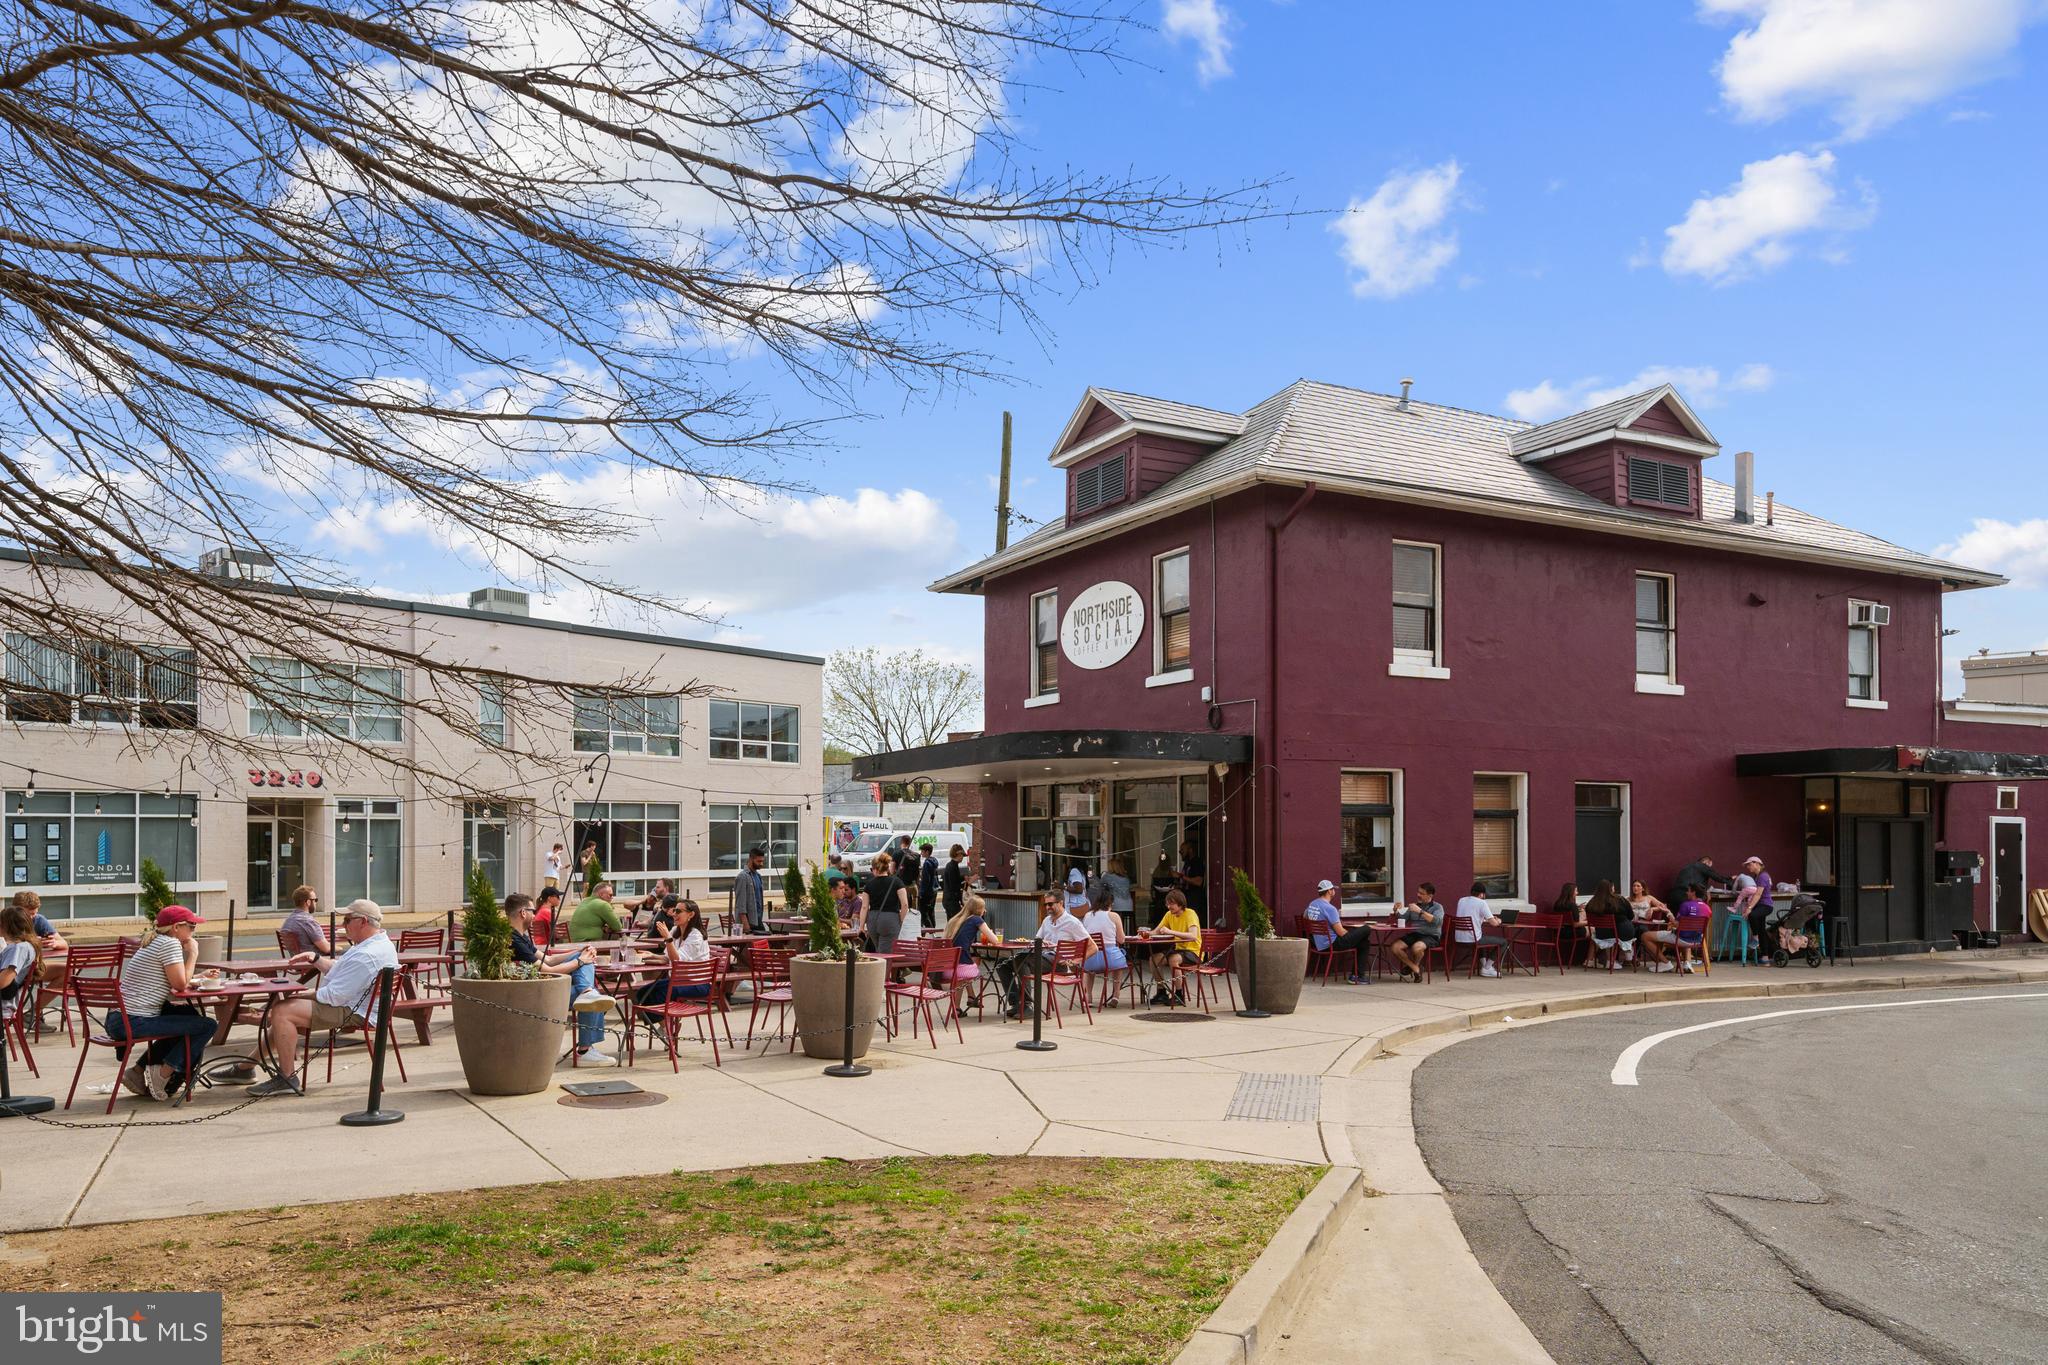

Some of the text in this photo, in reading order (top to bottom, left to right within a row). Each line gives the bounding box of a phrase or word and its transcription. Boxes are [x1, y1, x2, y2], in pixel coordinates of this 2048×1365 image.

[1073, 595, 1132, 628] NORTHSIDE
[1073, 616, 1132, 646] SOCIAL
[248, 769, 322, 788] 3240
